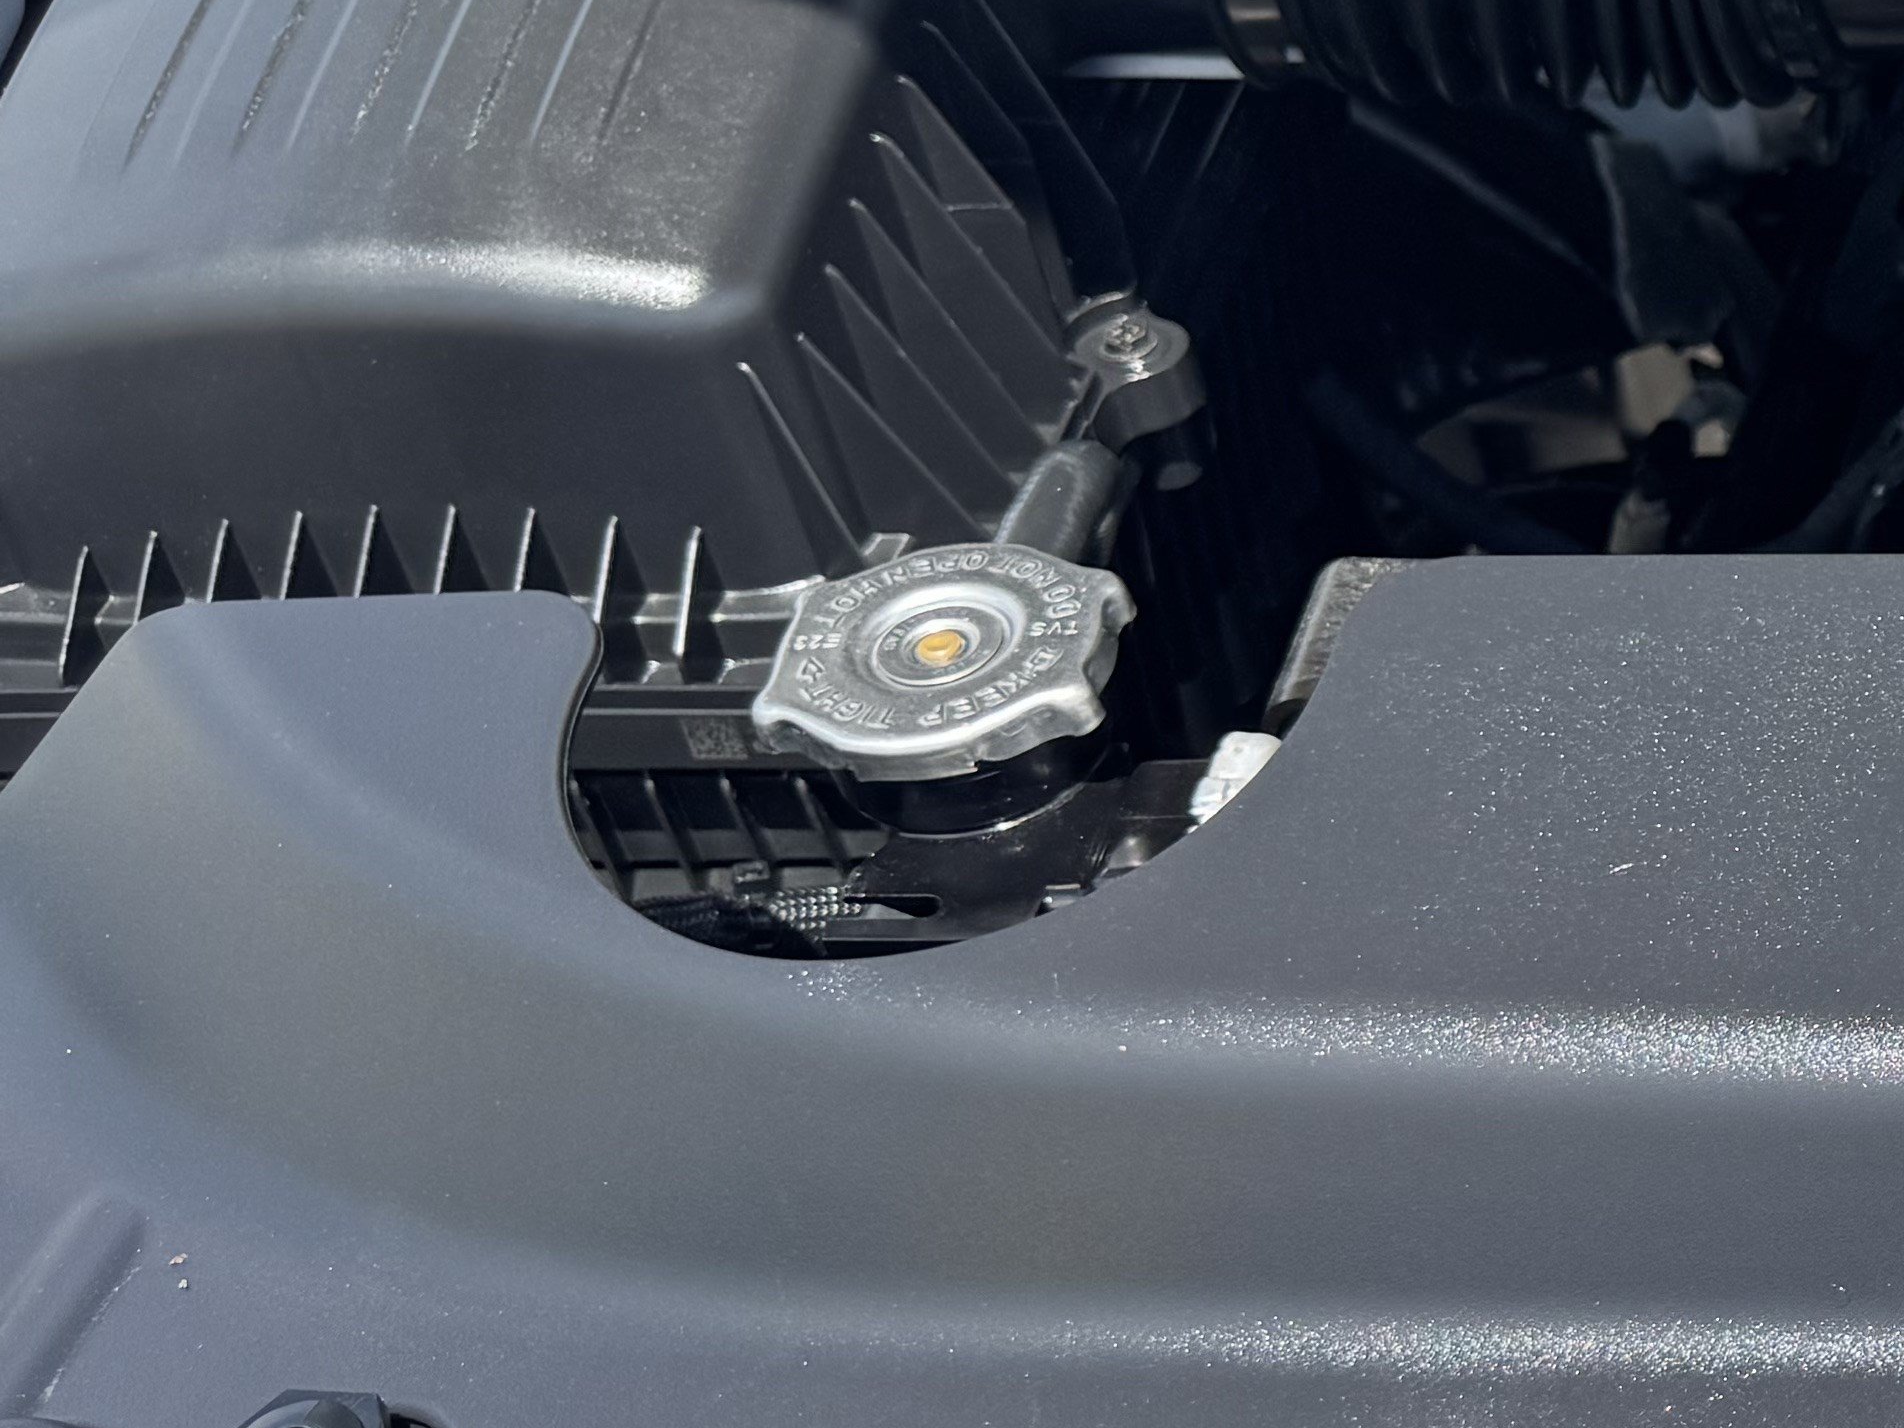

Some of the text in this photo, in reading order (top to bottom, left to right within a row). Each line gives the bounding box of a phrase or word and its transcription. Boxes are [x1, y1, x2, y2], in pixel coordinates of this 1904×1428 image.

[813, 549, 1083, 628] DO NOT OPEN HOT
[1028, 619, 1080, 638] TVS
[799, 668, 1030, 730] KEEP TIGHT
